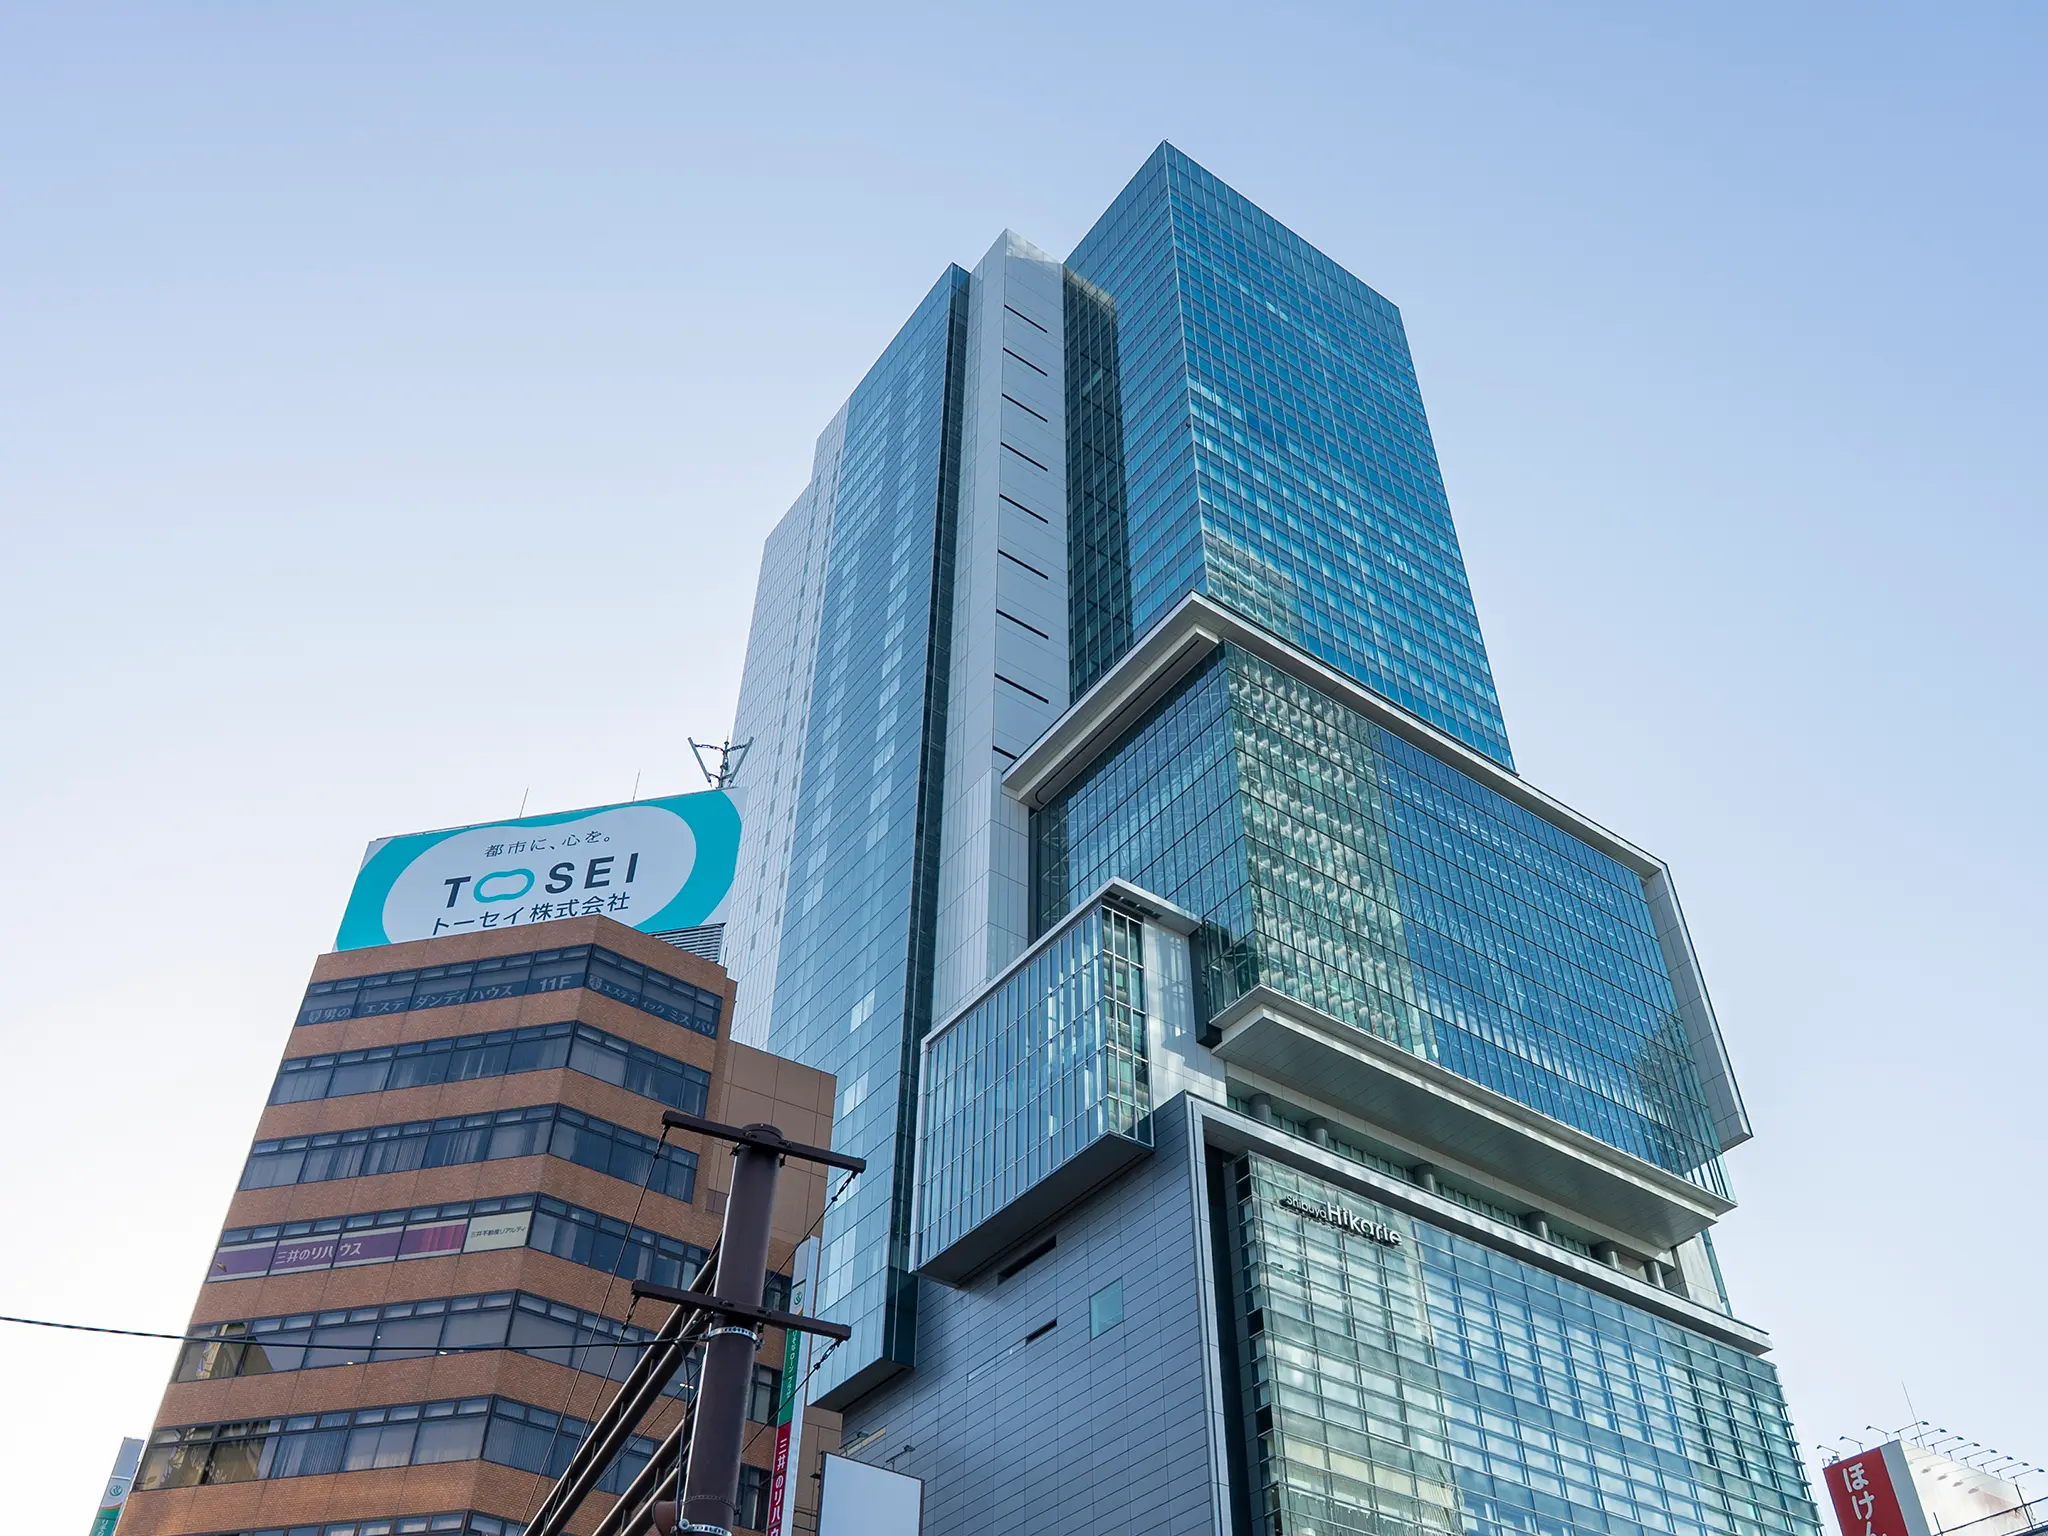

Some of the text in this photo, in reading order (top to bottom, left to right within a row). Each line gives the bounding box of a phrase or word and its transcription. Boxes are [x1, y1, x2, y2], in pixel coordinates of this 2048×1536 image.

[484, 831, 610, 857] 都市に、心を。
[444, 852, 639, 908] TOSEI
[433, 892, 630, 936] トーセイ株式会社
[540, 975, 572, 992] 11F
[1286, 1195, 1402, 1246] Shibuya Hikarie
[275, 1242, 362, 1264] 三井のリハウス
